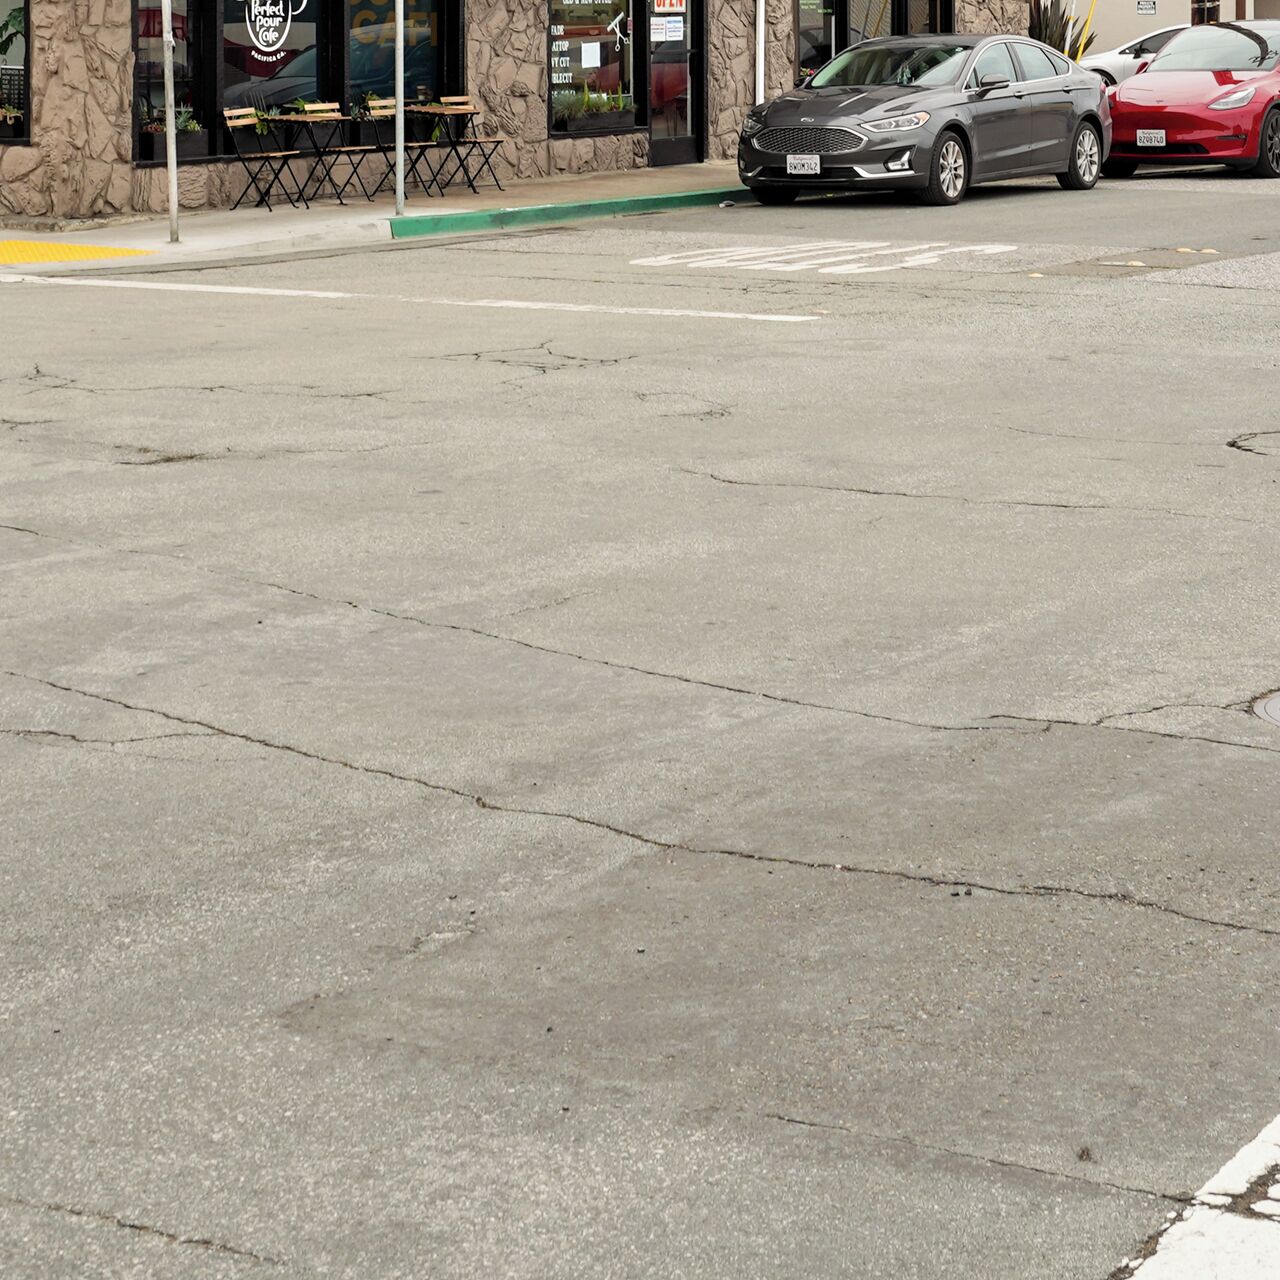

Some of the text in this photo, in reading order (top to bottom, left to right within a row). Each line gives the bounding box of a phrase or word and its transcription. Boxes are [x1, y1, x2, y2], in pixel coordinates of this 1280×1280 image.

[258, 27, 279, 46] Cafe
[251, 50, 277, 62] PACIFICA
[559, 56, 570, 68] CUT
